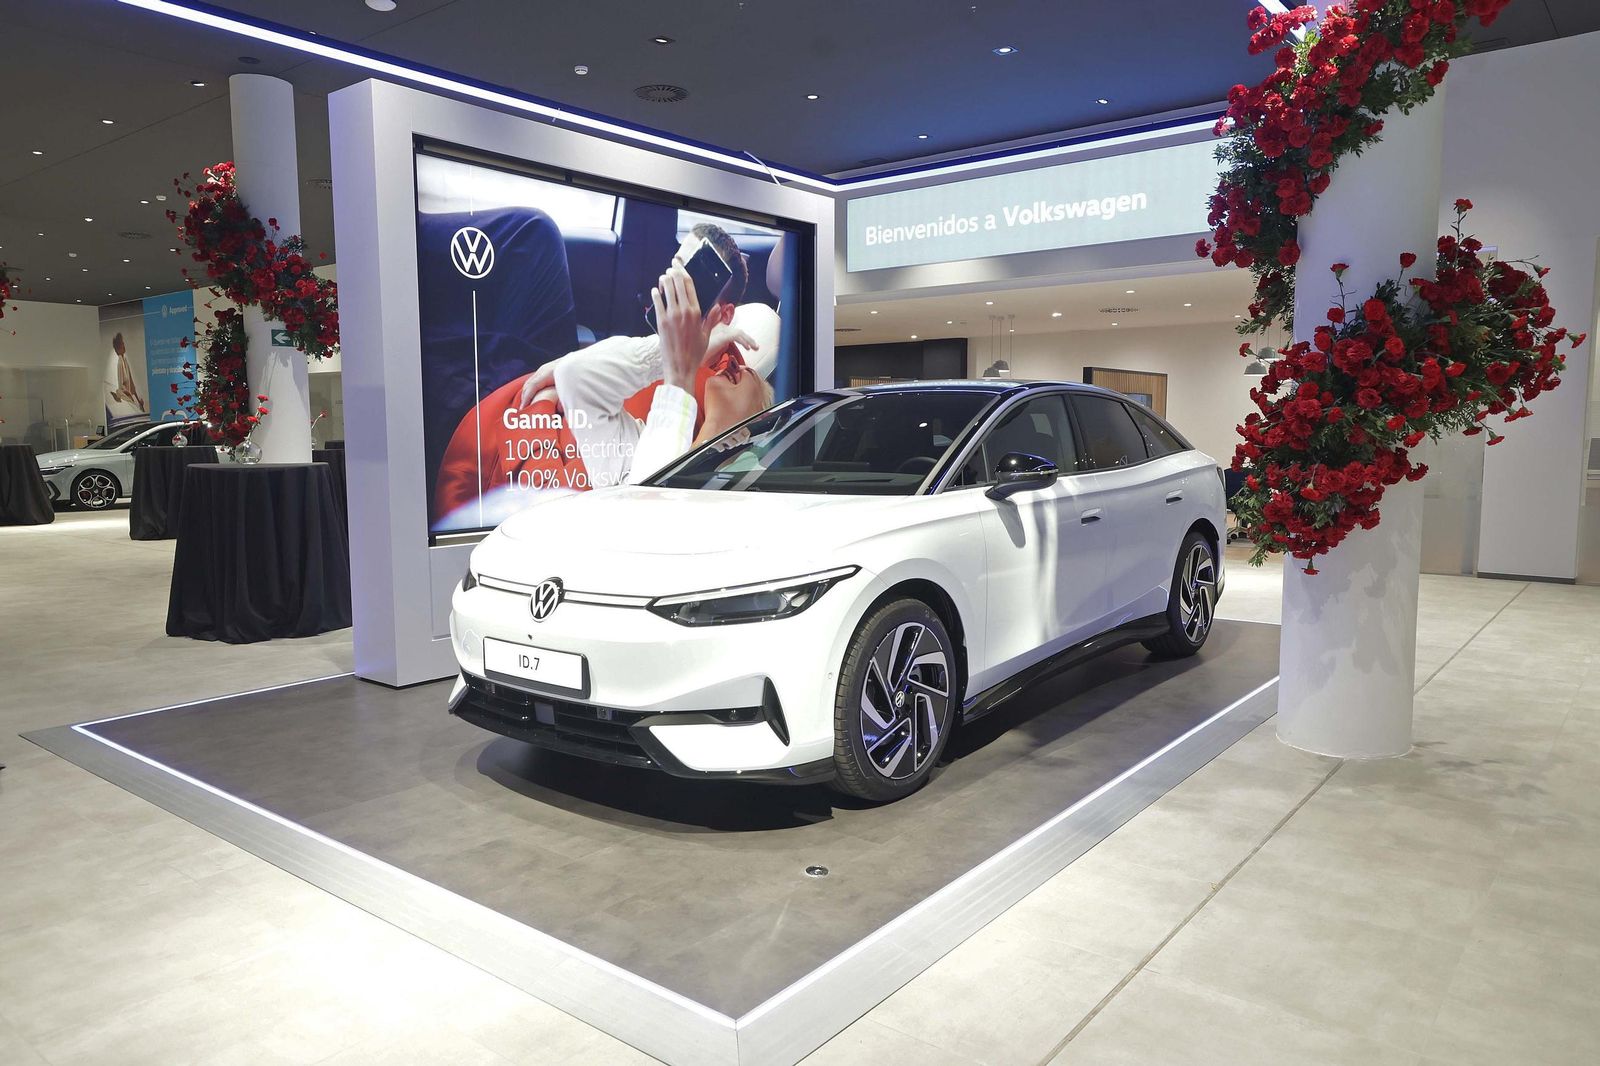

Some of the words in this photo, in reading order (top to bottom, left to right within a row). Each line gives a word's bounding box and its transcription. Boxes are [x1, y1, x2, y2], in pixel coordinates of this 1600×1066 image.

[865, 214, 978, 246] Bienvenidos
[984, 214, 996, 231] a
[1003, 192, 1147, 227] Volkswagen
[450, 226, 495, 279] VW
[503, 408, 563, 430] Gama
[568, 409, 592, 430] ID.
[505, 439, 560, 461] 100%
[565, 438, 634, 459] eléctrica
[506, 469, 560, 492] 100%
[564, 468, 632, 490] Volkswa
[518, 654, 540, 671] ID.7
